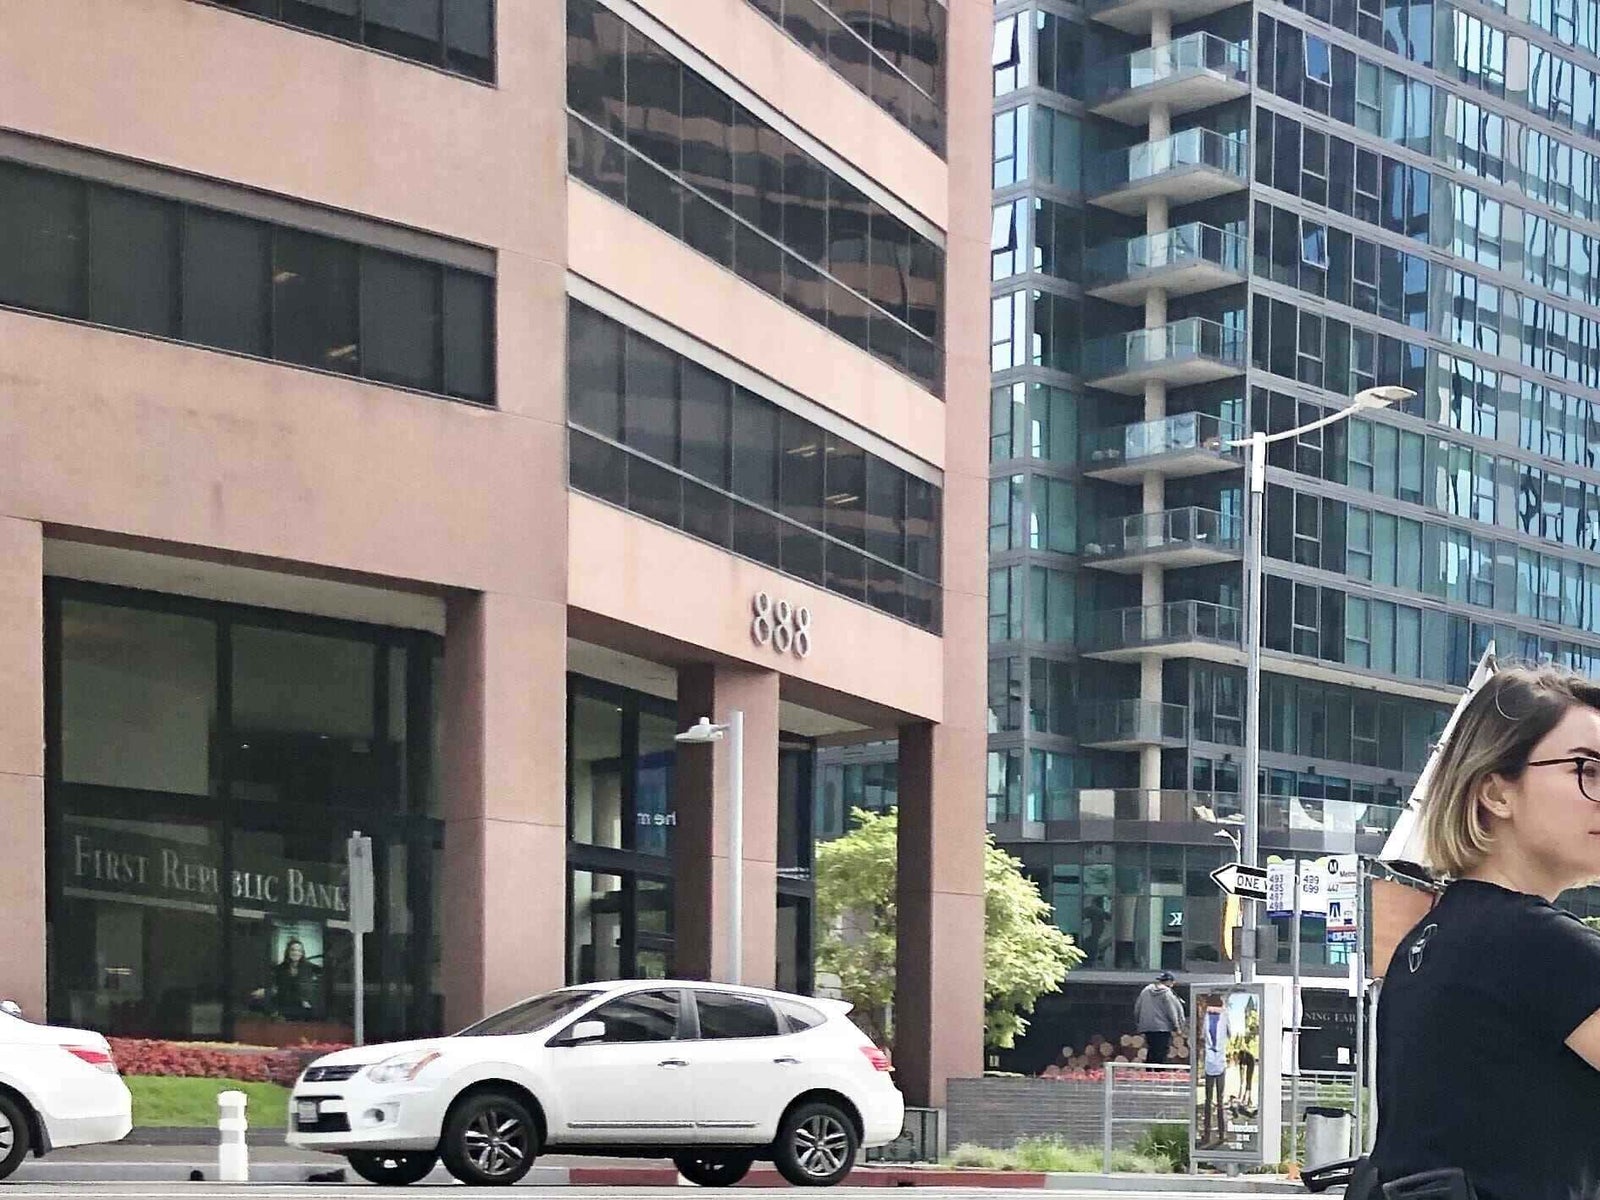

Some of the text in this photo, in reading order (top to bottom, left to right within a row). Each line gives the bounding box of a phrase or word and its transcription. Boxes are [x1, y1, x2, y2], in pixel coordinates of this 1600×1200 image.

[752, 591, 811, 658] 888
[74, 834, 149, 884] FIRST
[287, 868, 347, 912] BANK
[1236, 875, 1260, 890] ONE
